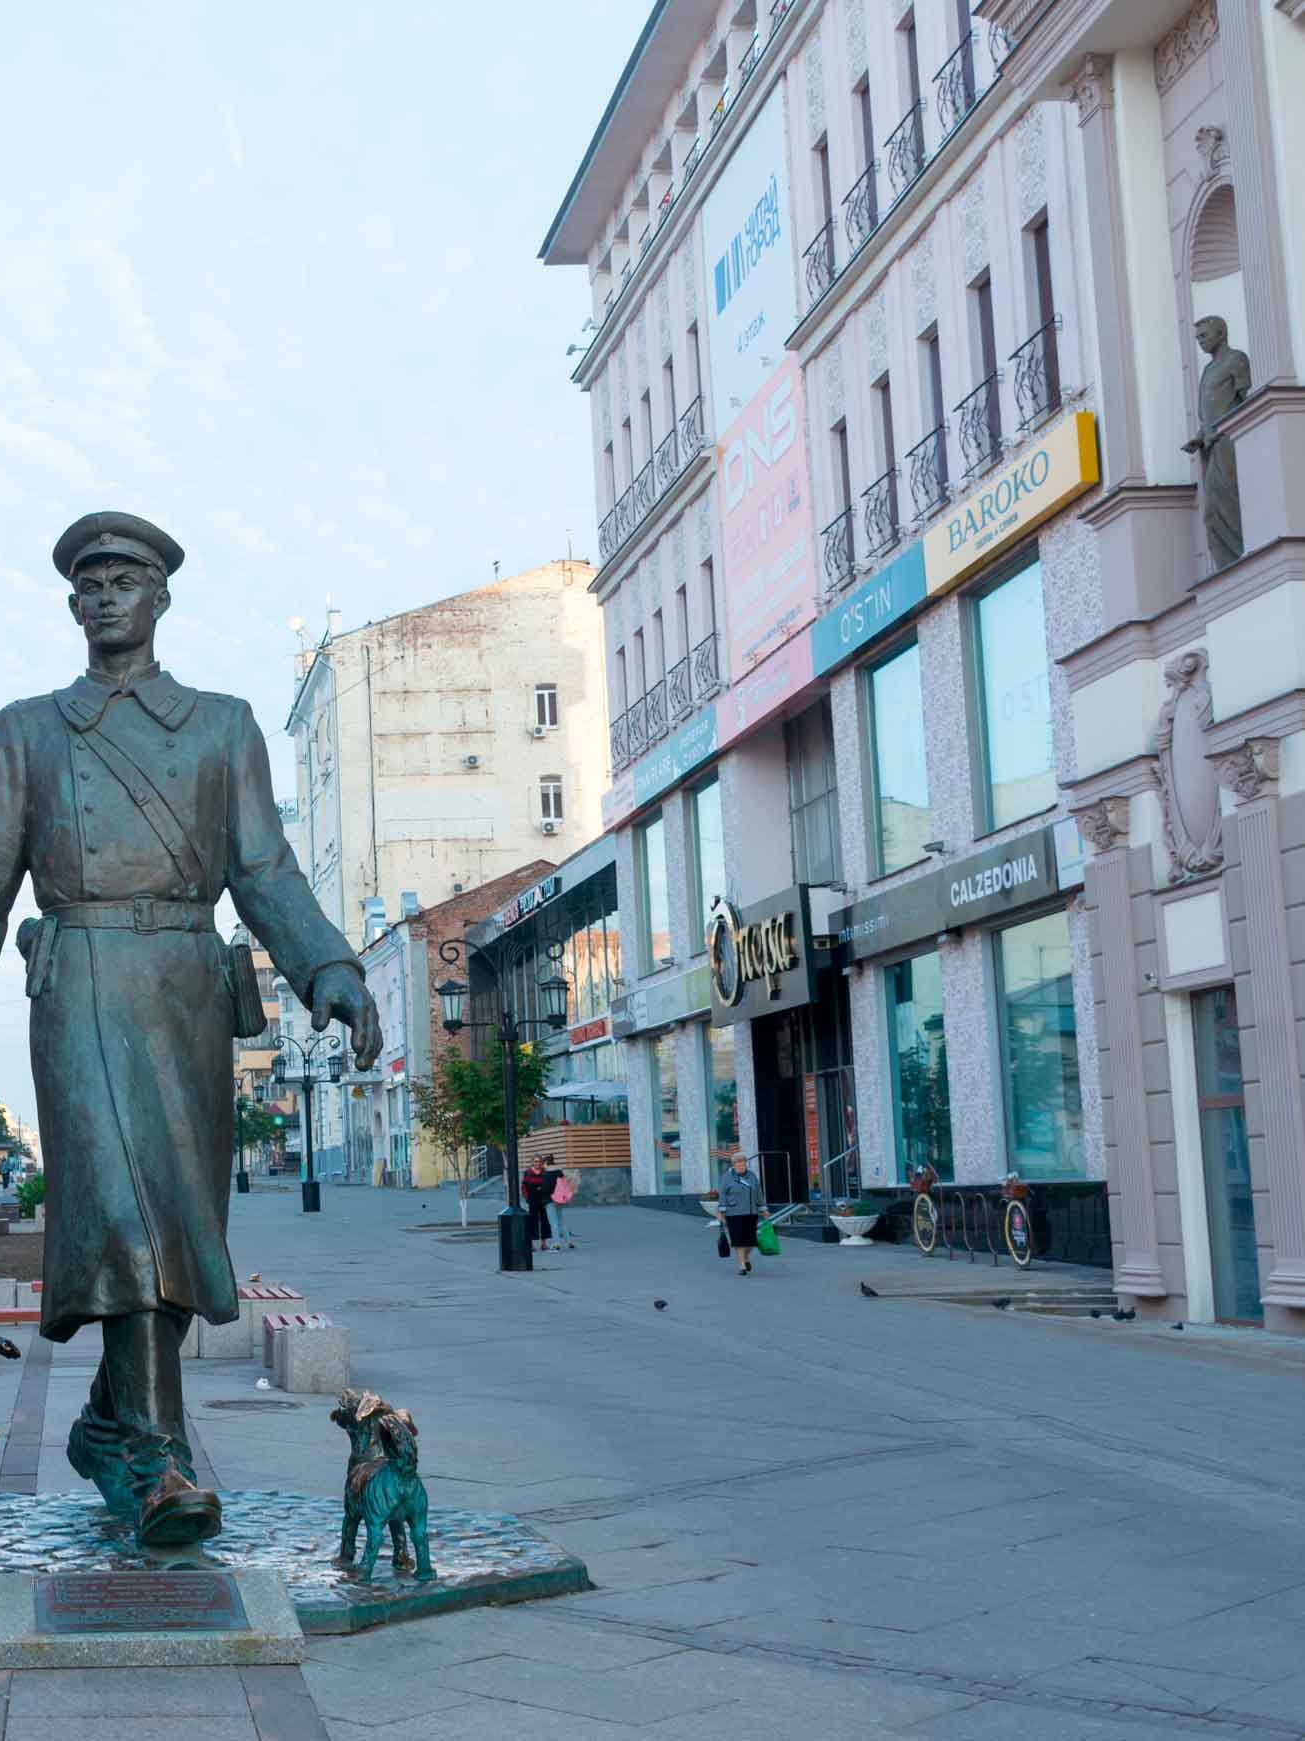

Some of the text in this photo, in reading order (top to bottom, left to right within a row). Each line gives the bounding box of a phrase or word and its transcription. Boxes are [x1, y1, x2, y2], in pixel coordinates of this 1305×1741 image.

[744, 172, 778, 238] ЧИТАЙ
[745, 208, 781, 278] ГОРОД
[724, 375, 797, 514] DNS
[947, 450, 1050, 553] BAROKO
[840, 579, 893, 643] O'STIN
[950, 854, 1039, 907] CALZEDONIA
